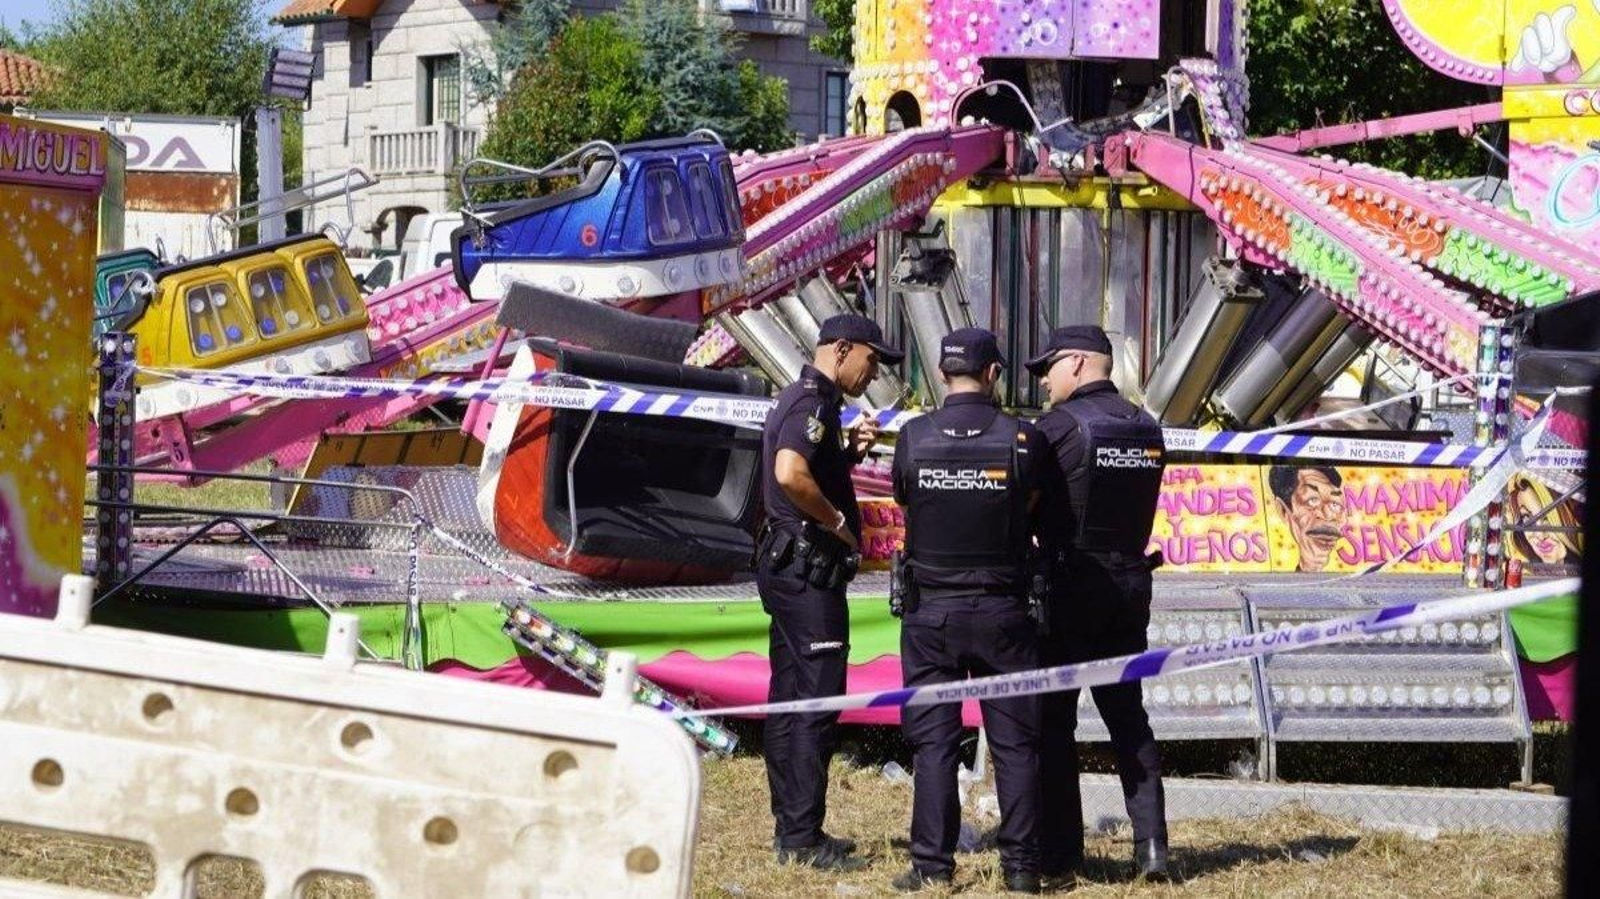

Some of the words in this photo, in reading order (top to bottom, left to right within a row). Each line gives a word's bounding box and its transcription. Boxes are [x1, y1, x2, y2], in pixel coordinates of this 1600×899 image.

[0, 123, 105, 176] MIGUEL
[581, 222, 599, 248] 6
[535, 395, 549, 405] NO
[551, 396, 586, 407] PASAR
[732, 408, 749, 418] NO
[1096, 447, 1150, 458] POLICIA
[1349, 448, 1367, 458] NO
[1368, 449, 1407, 460] PASAR
[1096, 458, 1161, 468] NACIONAL
[1553, 456, 1569, 467] NO
[918, 468, 989, 479] POLICIA
[918, 479, 1007, 490] NACIONAL
[1165, 517, 1184, 538] Y
[1261, 631, 1291, 646] NO
[992, 681, 1010, 693] DE
[1012, 676, 1051, 692] LINEA
[935, 685, 989, 700] POLICIA
